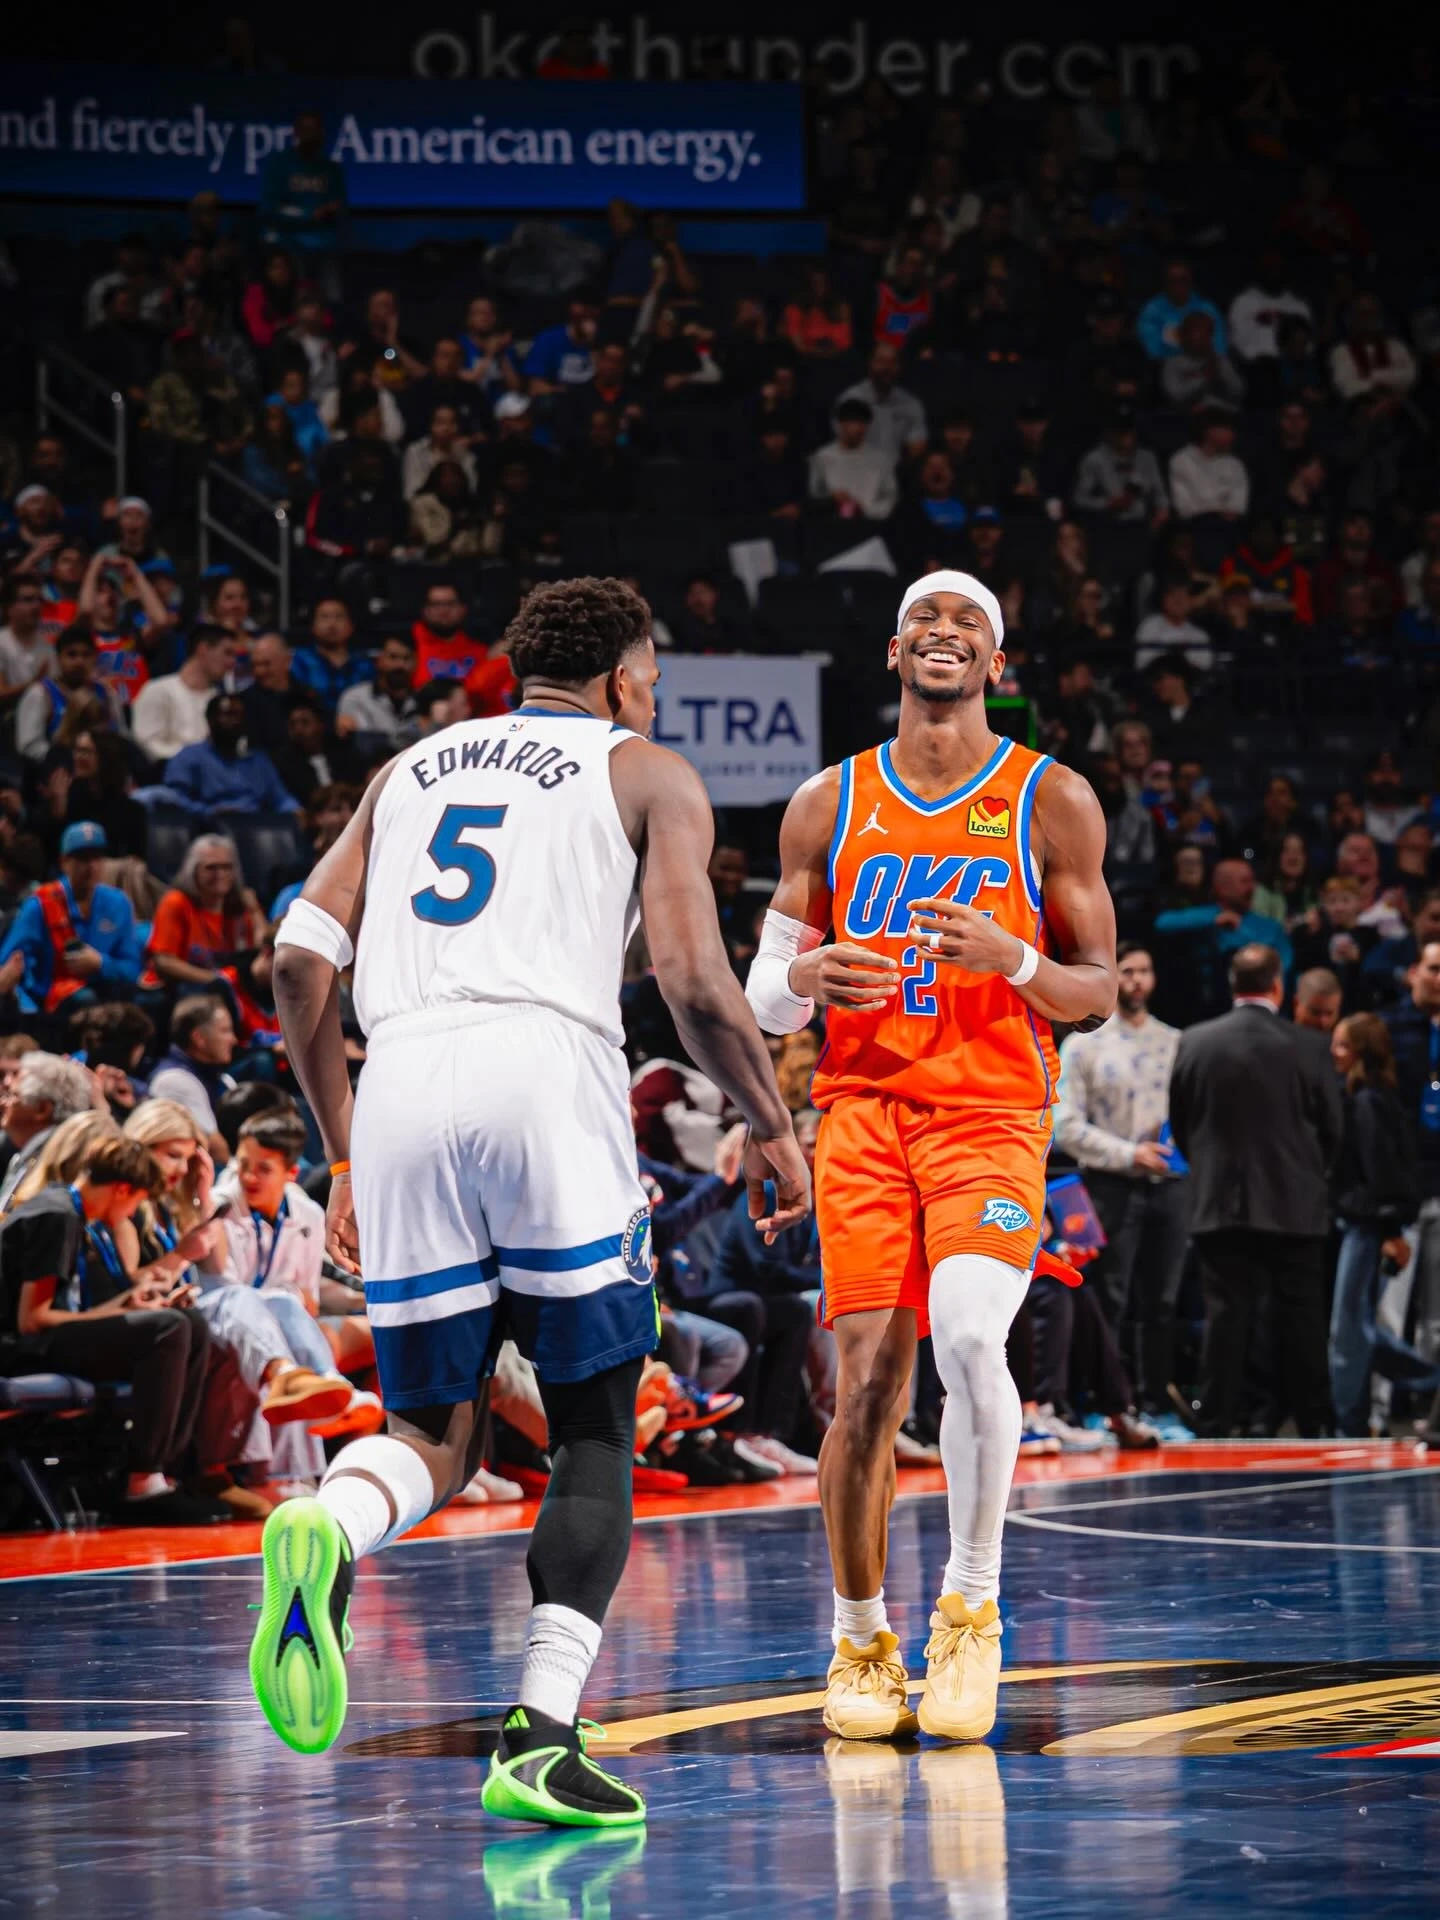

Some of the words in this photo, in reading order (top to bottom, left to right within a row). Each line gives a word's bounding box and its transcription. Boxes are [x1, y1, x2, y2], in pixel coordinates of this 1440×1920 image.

[71, 96, 235, 174] fiercely
[244, 122, 301, 175] pr
[585, 127, 762, 183] energy.
[410, 738, 581, 791] EDWARDS
[410, 803, 509, 927] 5
[845, 853, 1012, 940] OKC
[901, 944, 938, 1016] 2
